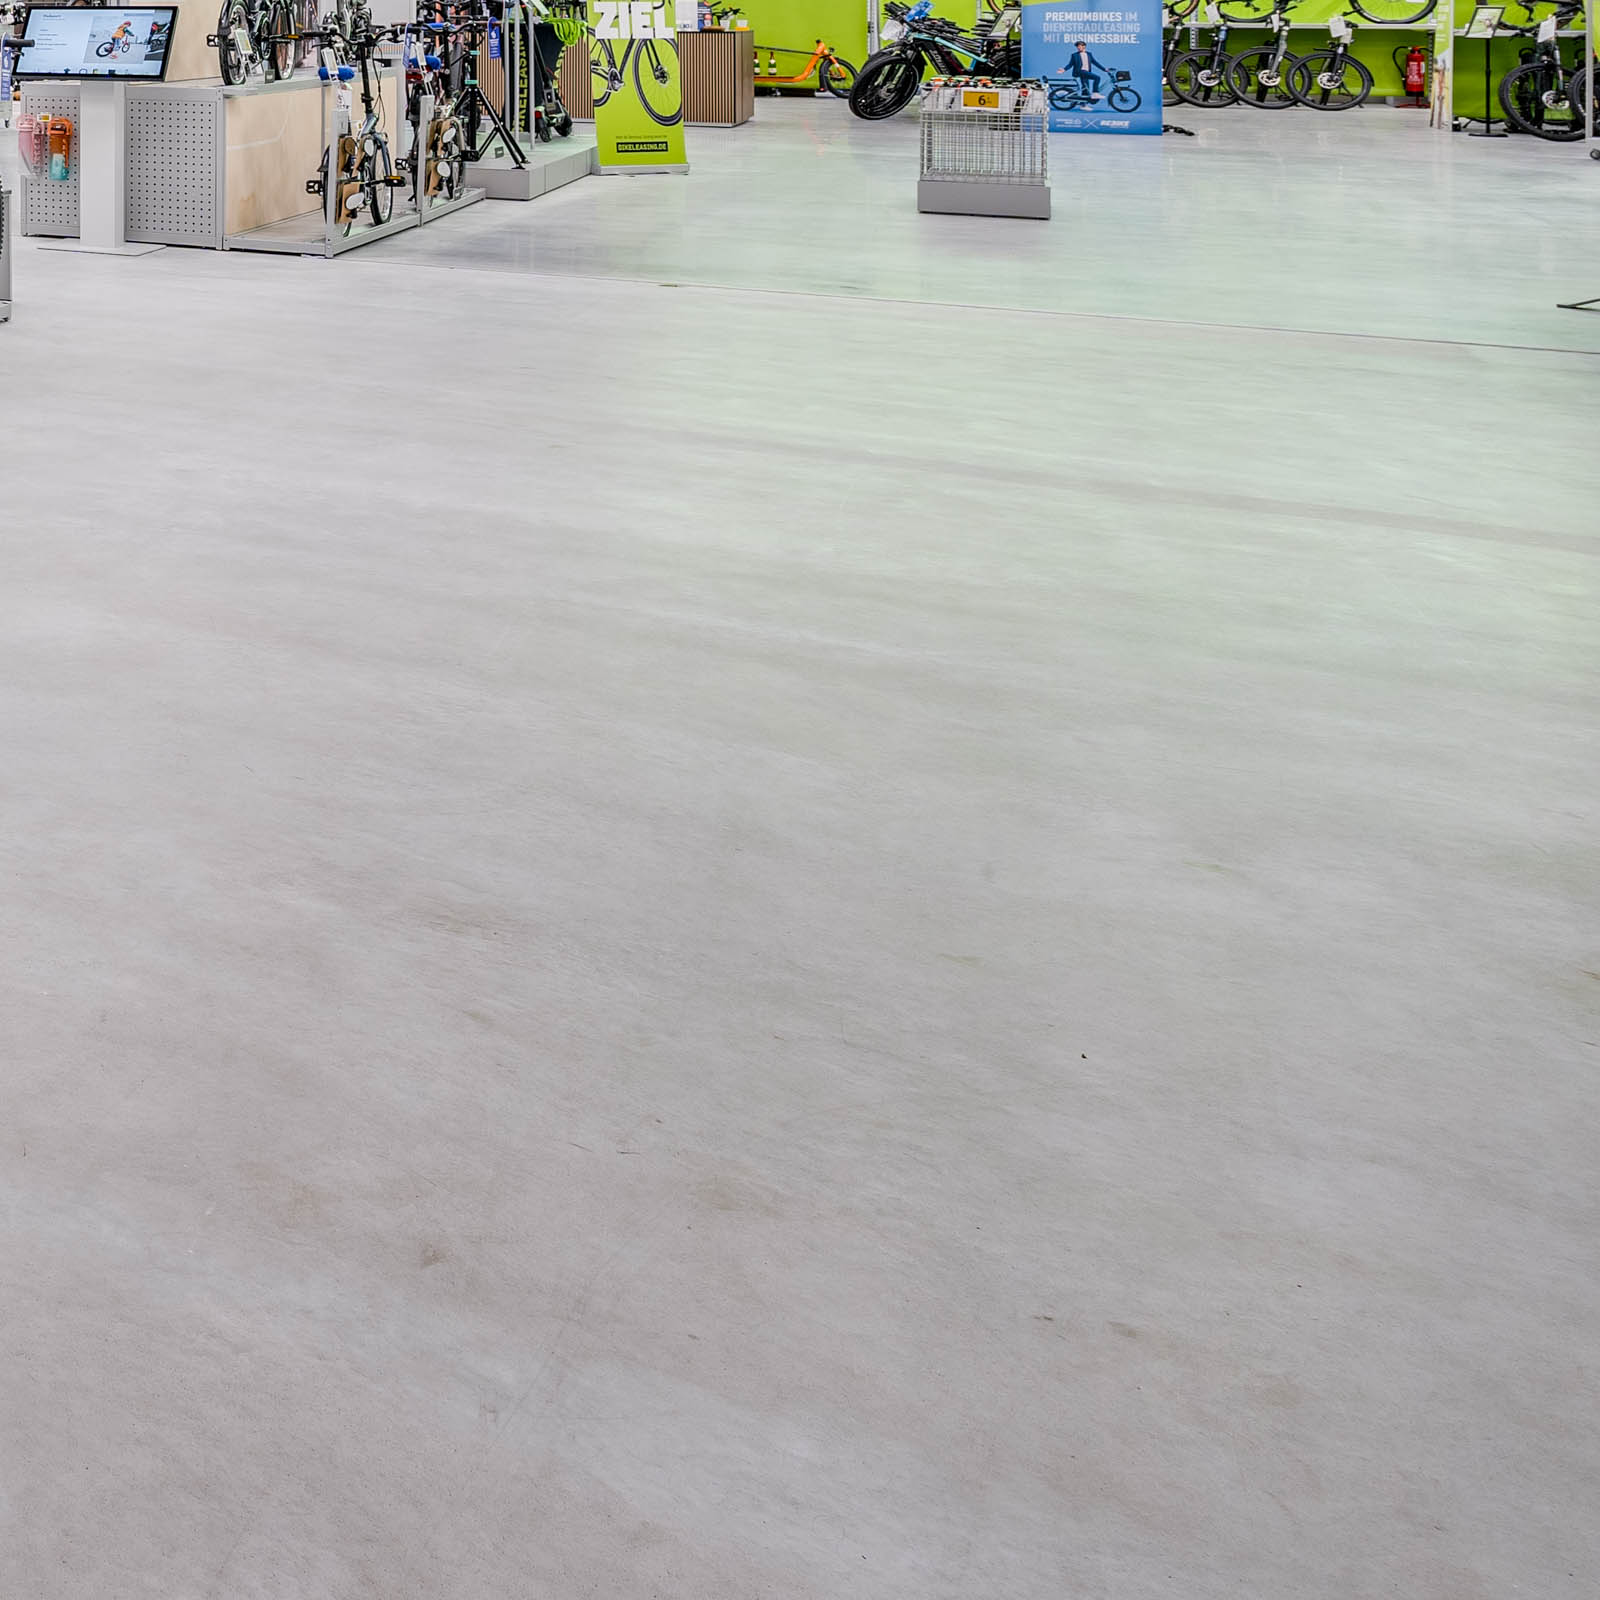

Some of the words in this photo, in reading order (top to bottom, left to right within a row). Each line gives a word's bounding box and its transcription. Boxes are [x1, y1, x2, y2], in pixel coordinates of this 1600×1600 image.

[594, 1, 675, 40] ZIEL
[1045, 12, 1122, 21] PREMIUMBIKES
[1125, 12, 1138, 21] IM
[1043, 23, 1140, 32] DIENSTRADLEASING
[1043, 34, 1061, 43] MIT
[1063, 34, 1140, 44] BUSINESSBIKE.
